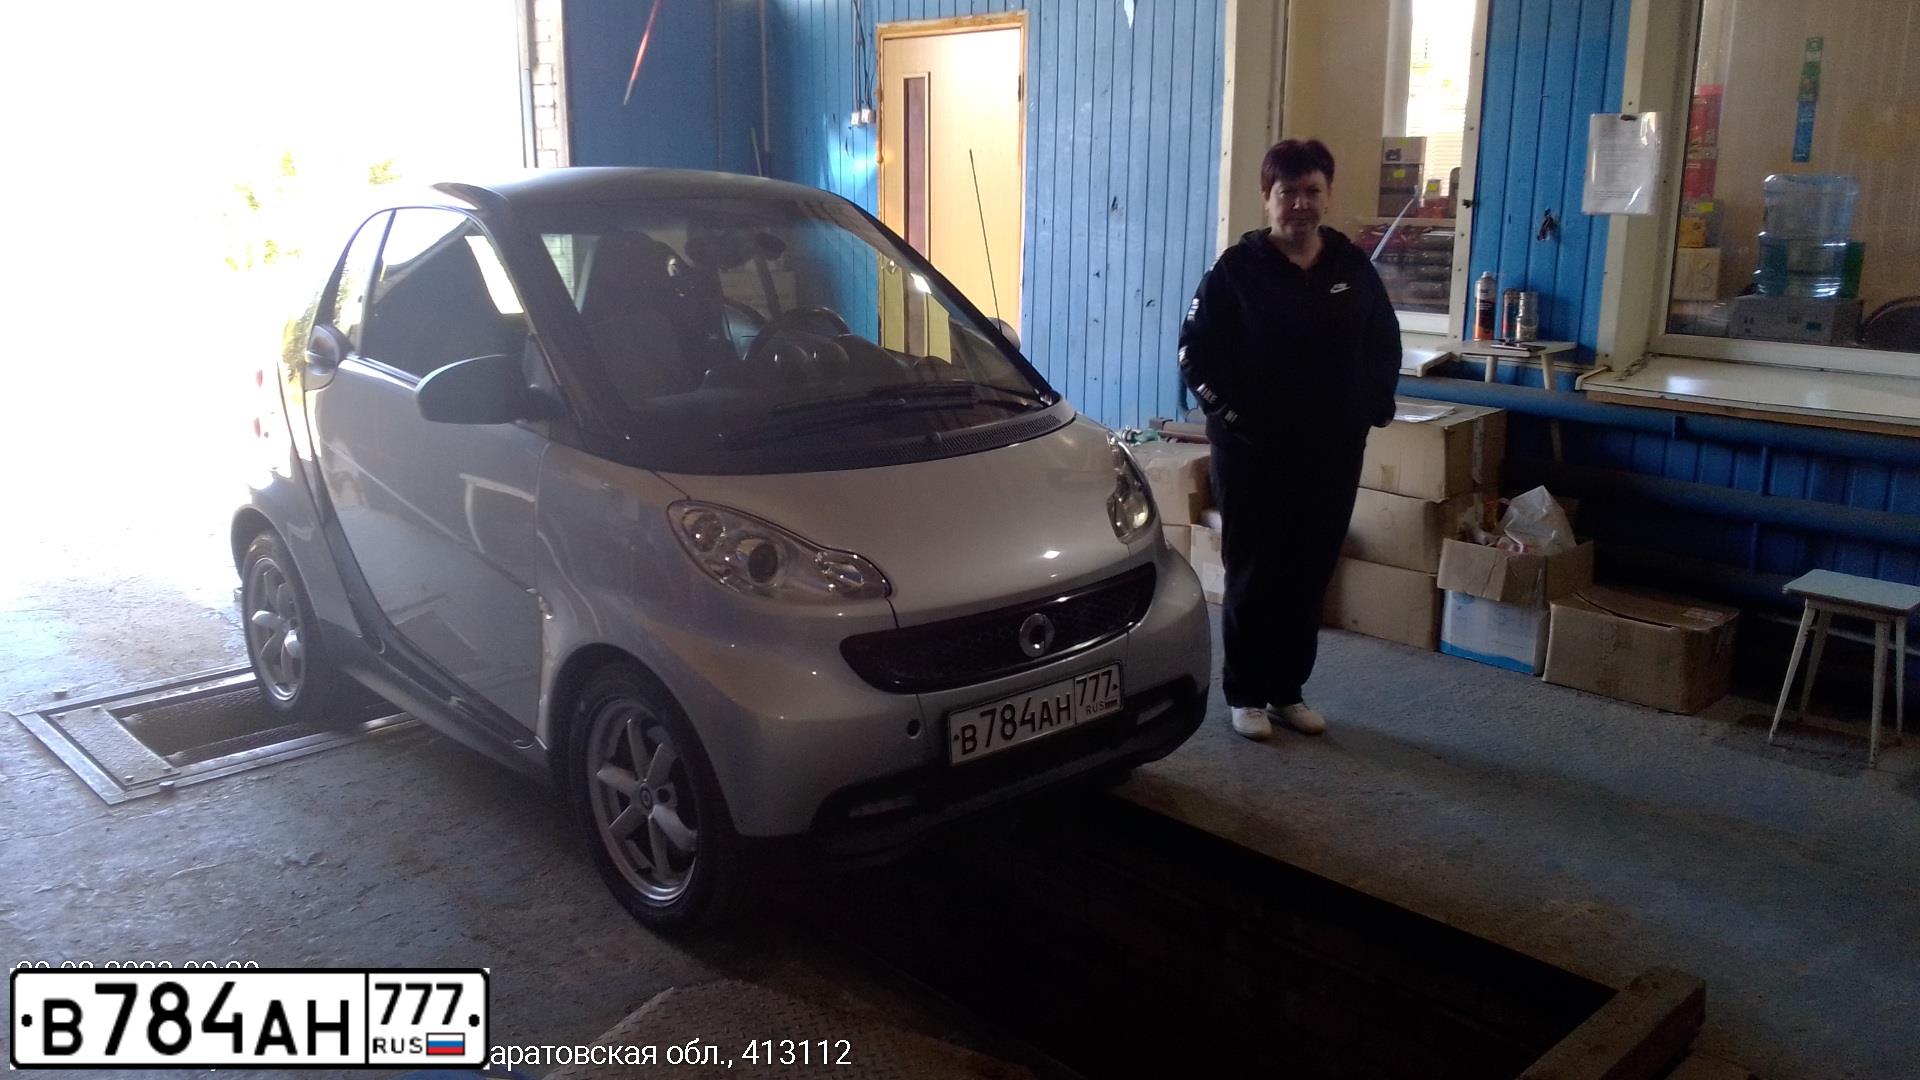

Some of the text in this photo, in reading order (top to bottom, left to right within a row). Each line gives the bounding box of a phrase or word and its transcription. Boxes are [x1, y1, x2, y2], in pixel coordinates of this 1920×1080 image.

[961, 671, 1112, 755] В784АН 777
[1086, 703, 1105, 715] RUS
